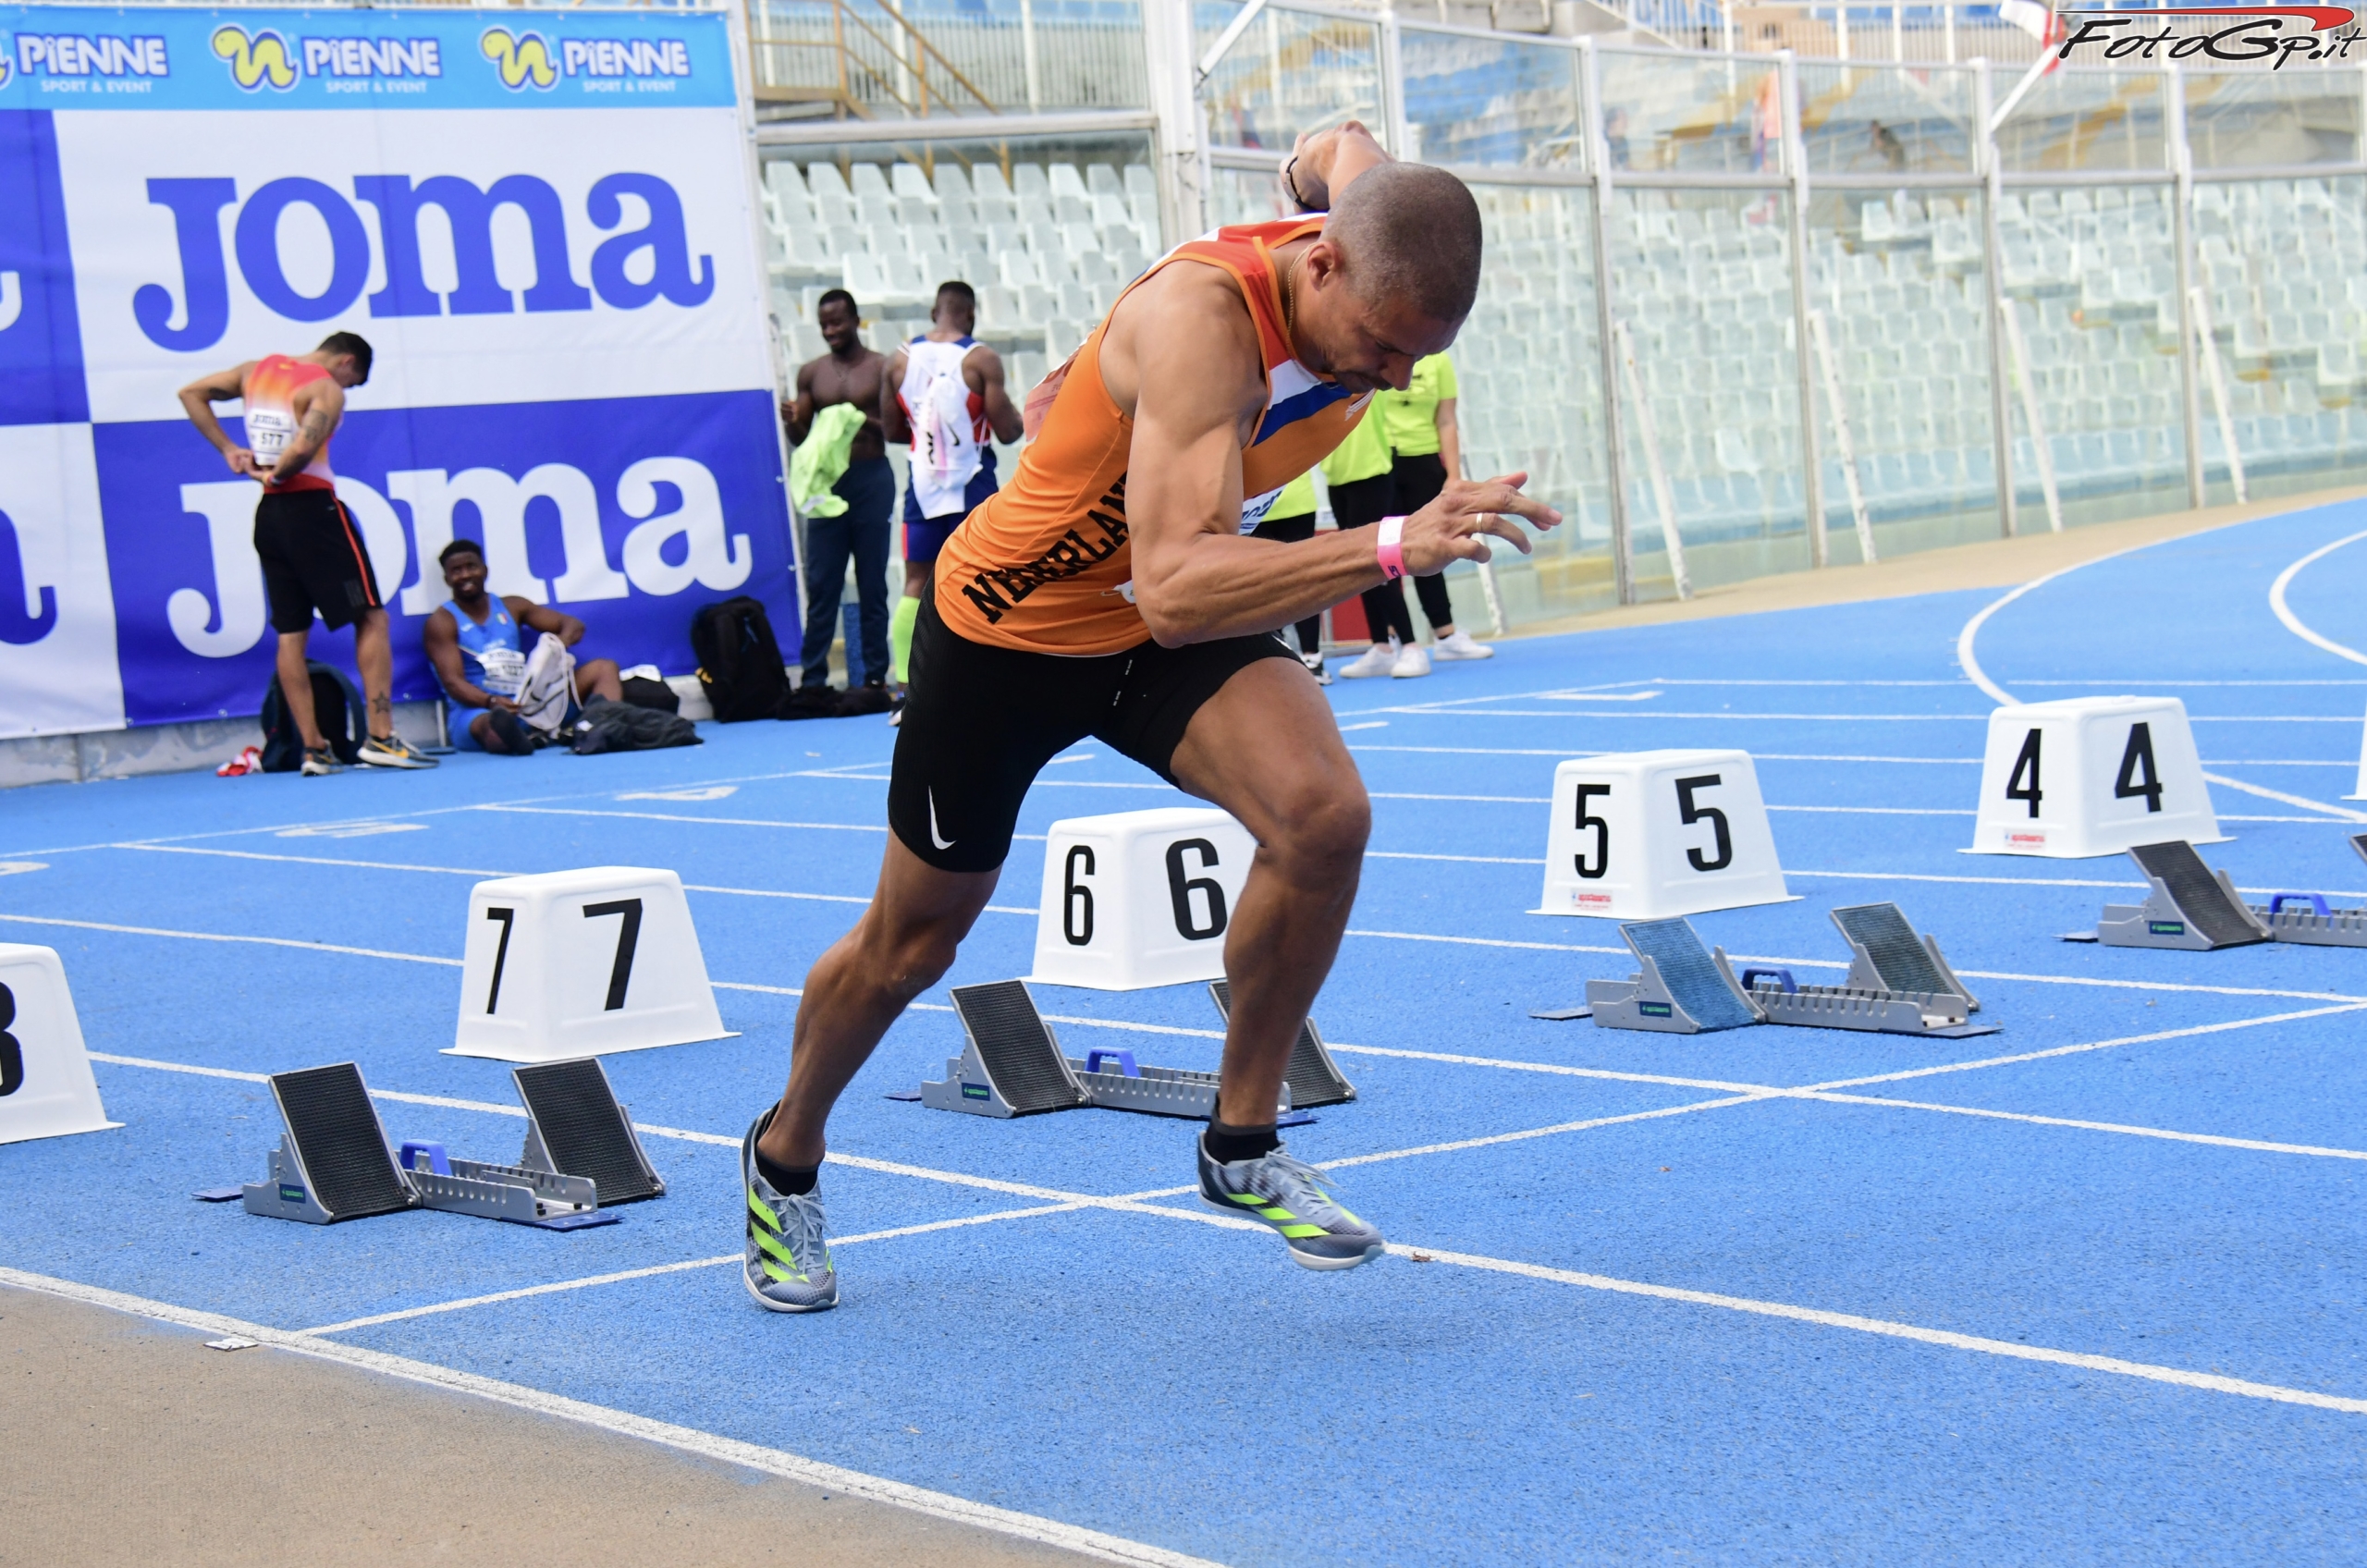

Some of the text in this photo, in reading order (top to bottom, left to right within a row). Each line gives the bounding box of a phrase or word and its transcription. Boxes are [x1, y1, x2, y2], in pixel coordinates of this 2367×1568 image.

[41, 80, 152, 92] SPORT & EVENT
[325, 80, 426, 92] SPORT & EVENT
[583, 80, 620, 92] SPORT
[638, 80, 676, 92] EVENT
[262, 433, 283, 445] 577
[2005, 729, 2043, 818] 4
[2115, 721, 2163, 814] 4
[1575, 784, 1611, 878] 5
[1675, 774, 1733, 872] 5
[1063, 845, 1096, 946] 6
[1165, 838, 1228, 941] 6
[487, 908, 514, 1014] 7
[583, 899, 643, 1011] 7
